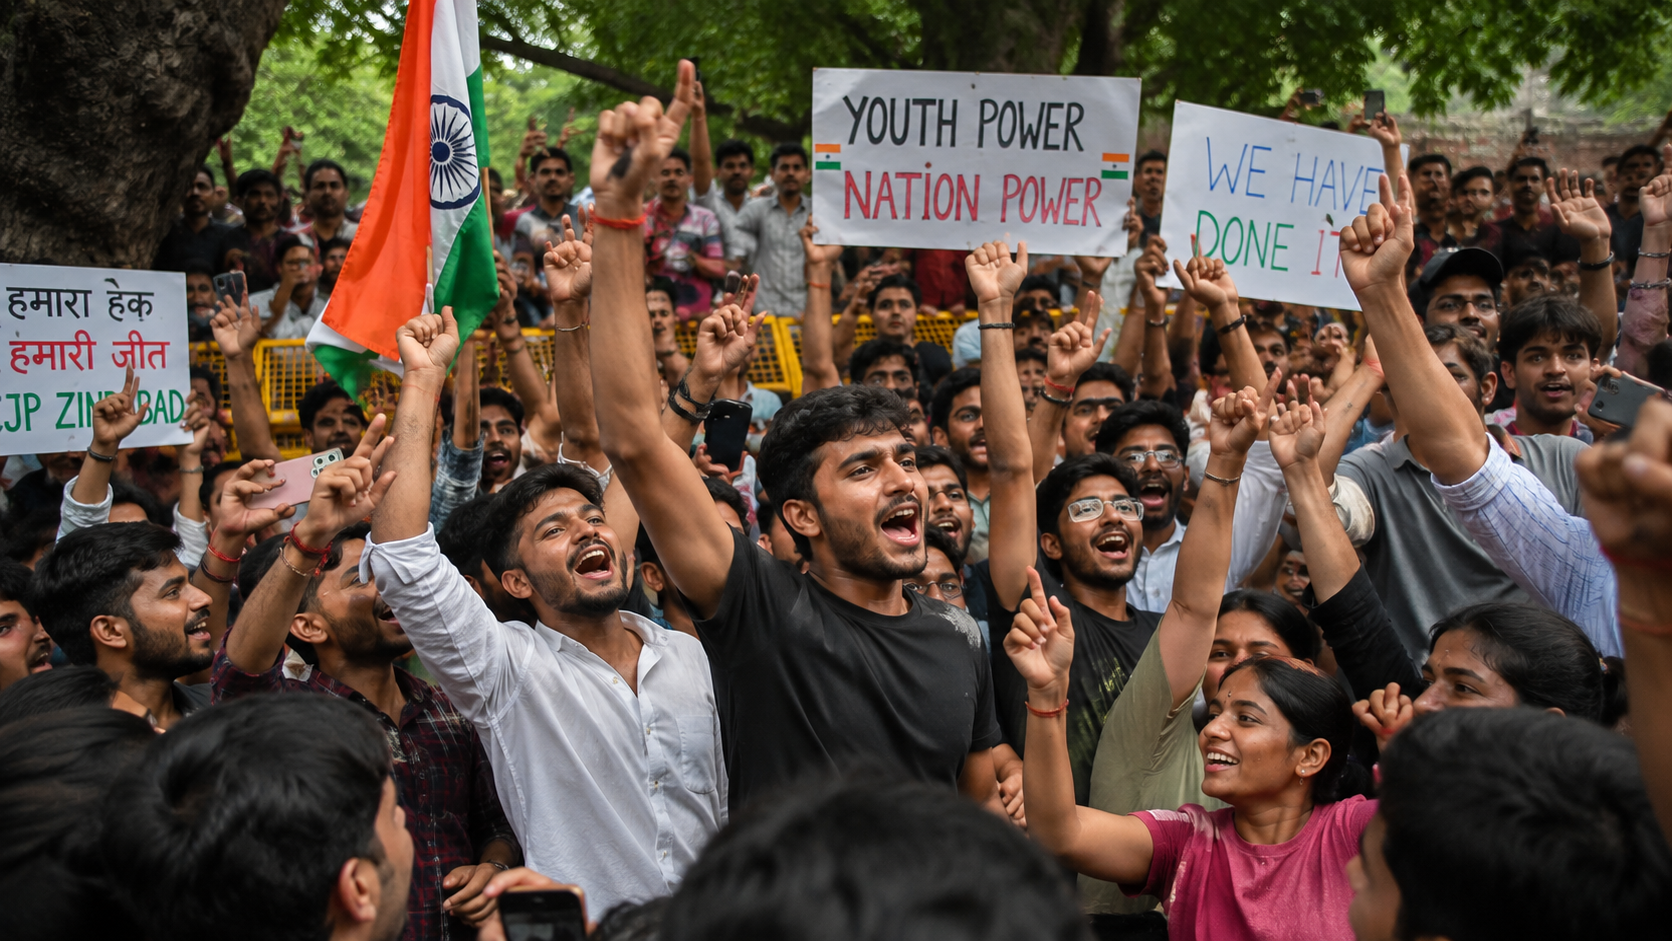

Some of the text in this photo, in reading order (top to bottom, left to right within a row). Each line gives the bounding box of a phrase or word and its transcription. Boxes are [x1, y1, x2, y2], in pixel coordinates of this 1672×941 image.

[842, 95, 1085, 152] YOUTH POWER
[1000, 173, 1102, 227] POWER
[1206, 136, 1384, 215] WE HAVE
[1194, 209, 1295, 272] DONE
[6, 286, 93, 320] हमारा
[9, 329, 171, 375] हमारी जीत
[0, 389, 185, 433] JP ZINBAD
